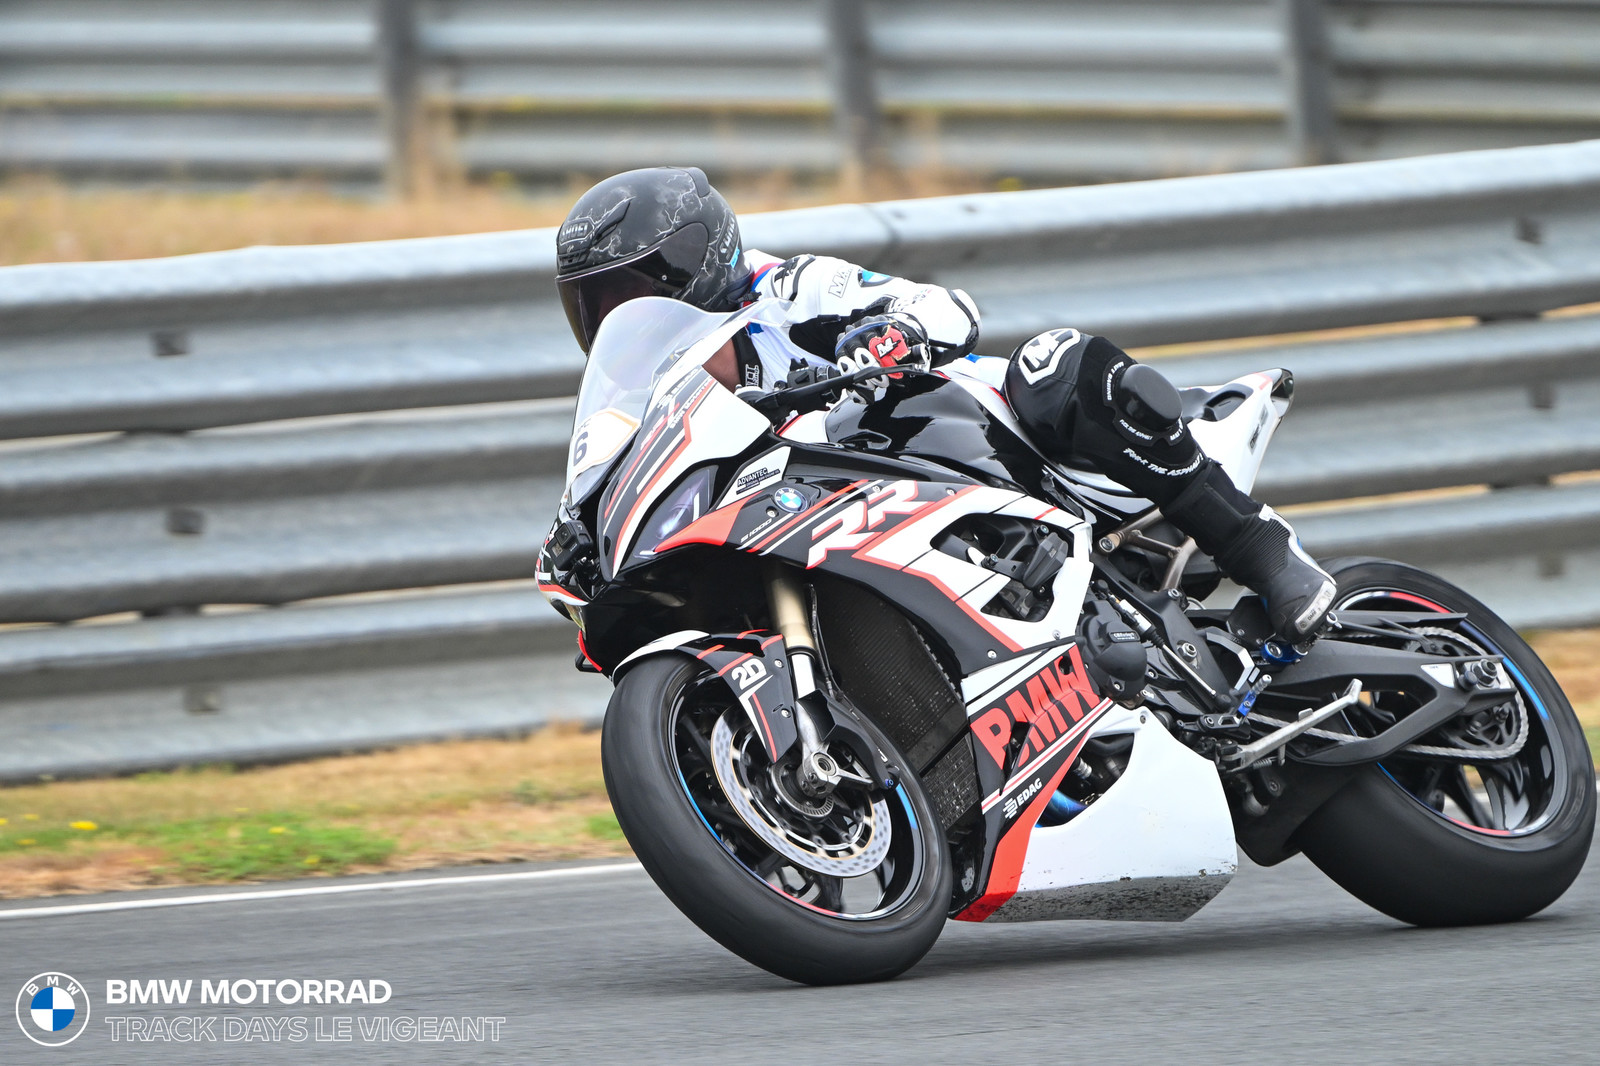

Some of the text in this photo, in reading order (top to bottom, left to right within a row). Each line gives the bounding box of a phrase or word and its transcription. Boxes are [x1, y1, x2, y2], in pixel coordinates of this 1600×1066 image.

[737, 467, 769, 487] ADVANTEC
[1147, 463, 1168, 475] THE
[740, 517, 773, 544] S 1000
[805, 479, 936, 570] RR
[731, 658, 767, 690] 2D
[969, 643, 1101, 771] BMW
[1016, 777, 1042, 807] EDAG
